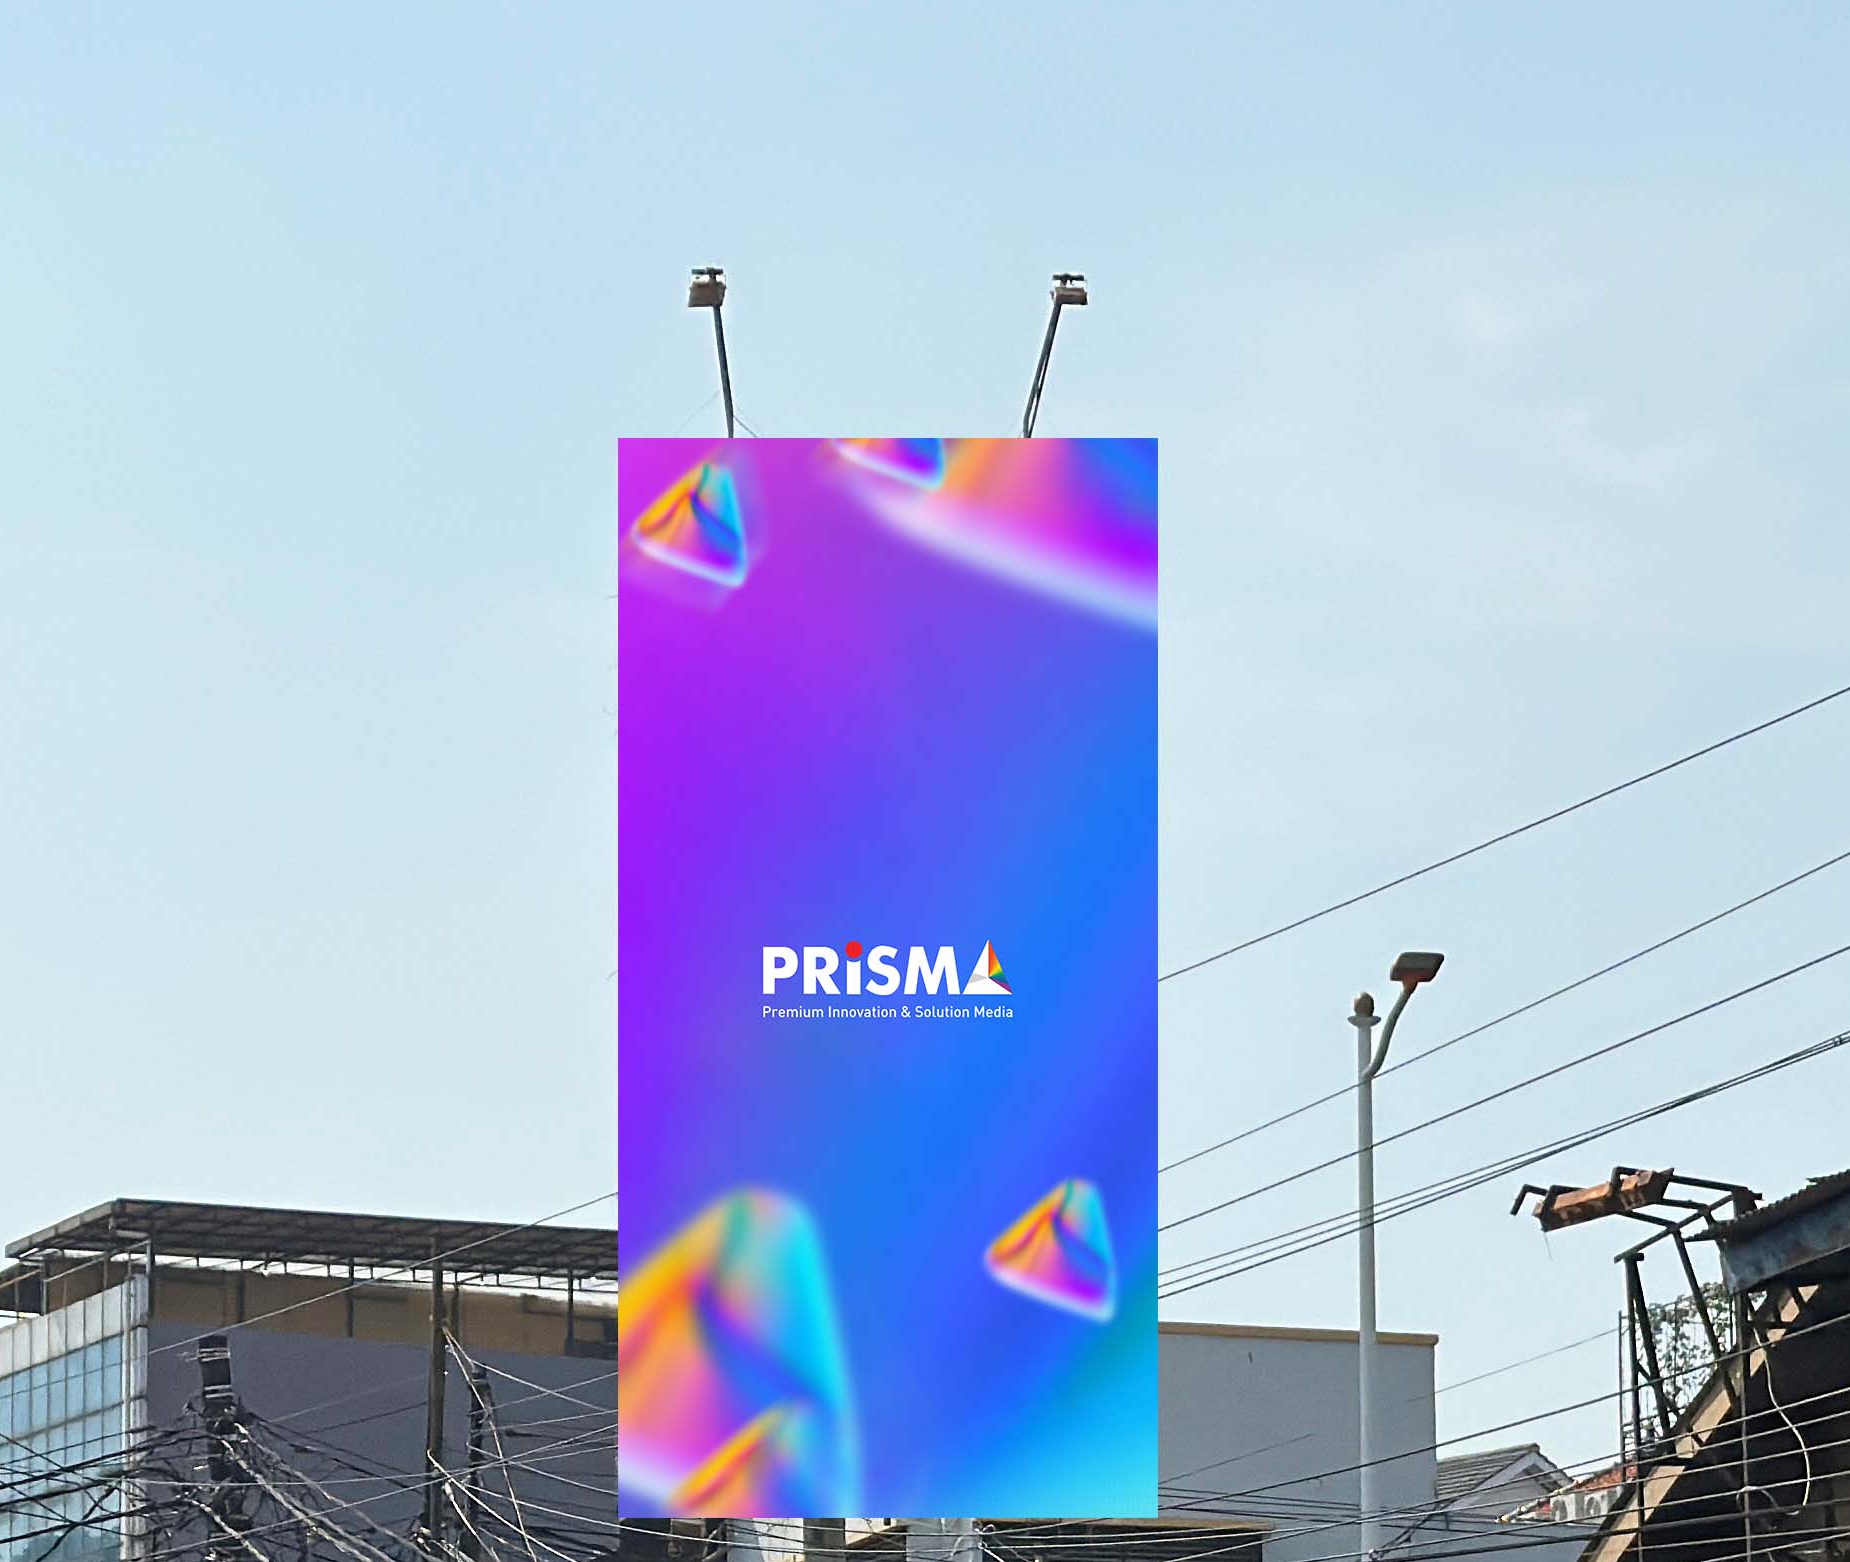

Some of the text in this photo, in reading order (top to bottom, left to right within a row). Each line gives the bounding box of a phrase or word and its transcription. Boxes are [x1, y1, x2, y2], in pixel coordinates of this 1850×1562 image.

[762, 1004, 1014, 1019] Premium Innovation & Solution Media
